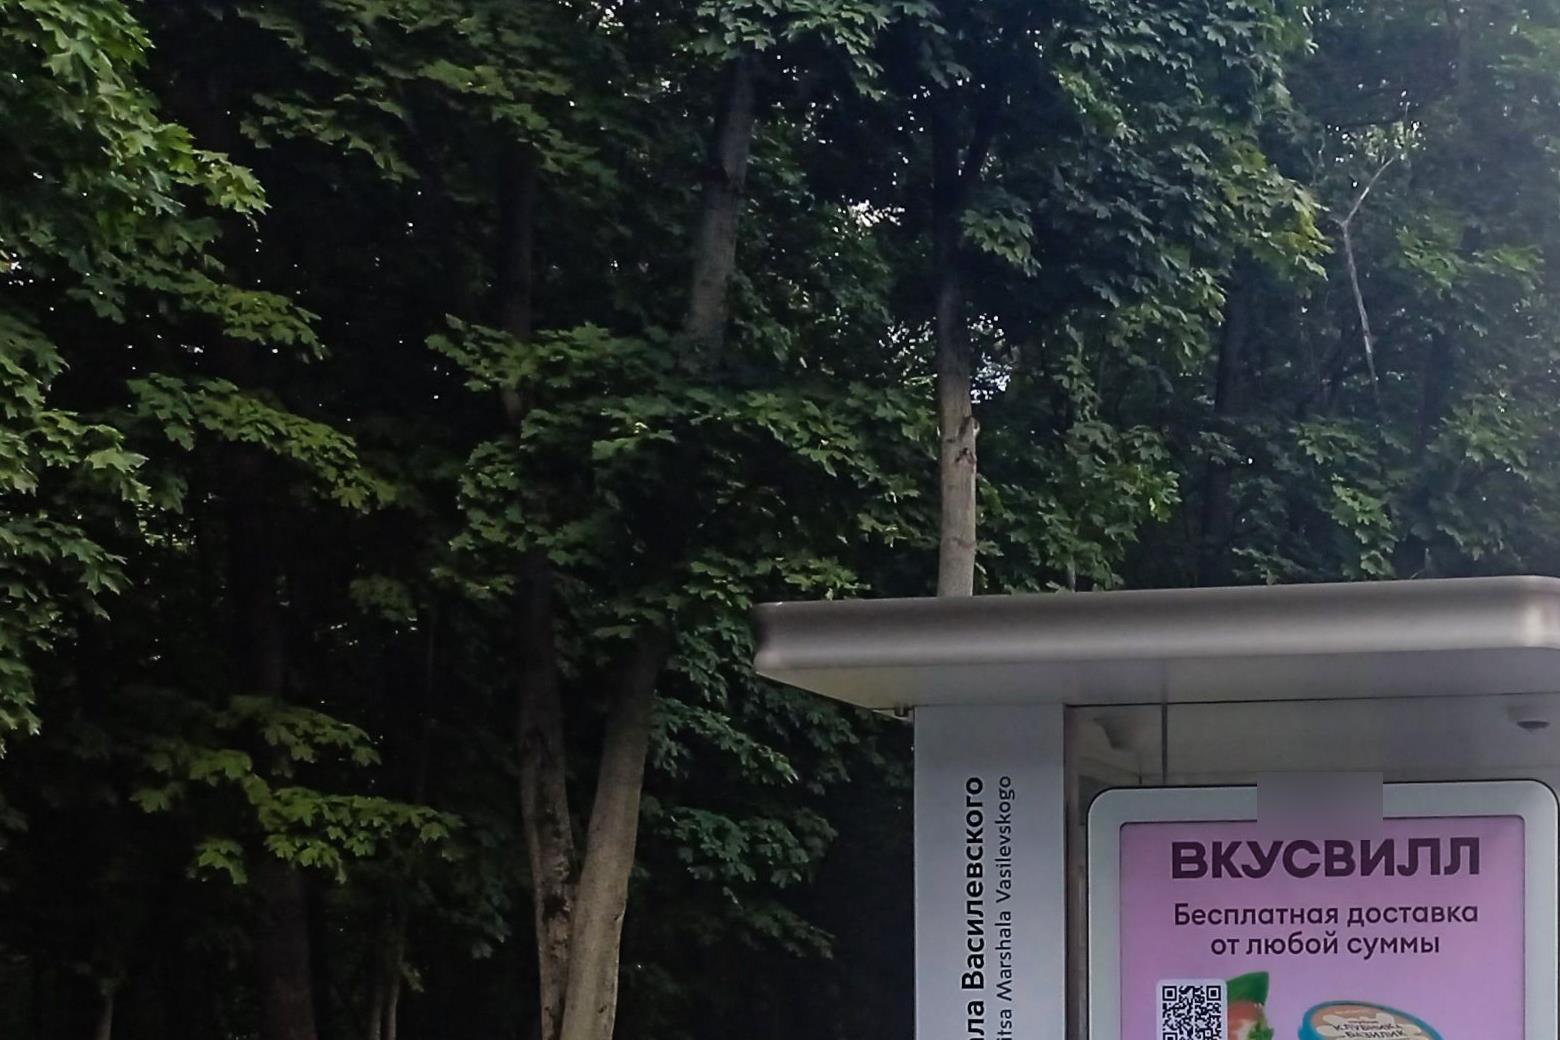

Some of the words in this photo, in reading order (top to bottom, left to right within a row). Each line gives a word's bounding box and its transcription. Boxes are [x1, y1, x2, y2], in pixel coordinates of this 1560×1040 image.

[994, 776, 1015, 903] Vasilevskogo
[1171, 837, 1480, 879] ВКУСВИЛЛ
[961, 777, 984, 990] Василевского
[1174, 903, 1338, 926] Бесплатная
[1347, 905, 1478, 928] доставка
[995, 911, 1012, 1001] Marshala
[1211, 936, 1239, 955] от
[1247, 931, 1338, 955] любой
[1347, 936, 1439, 960] суммы
